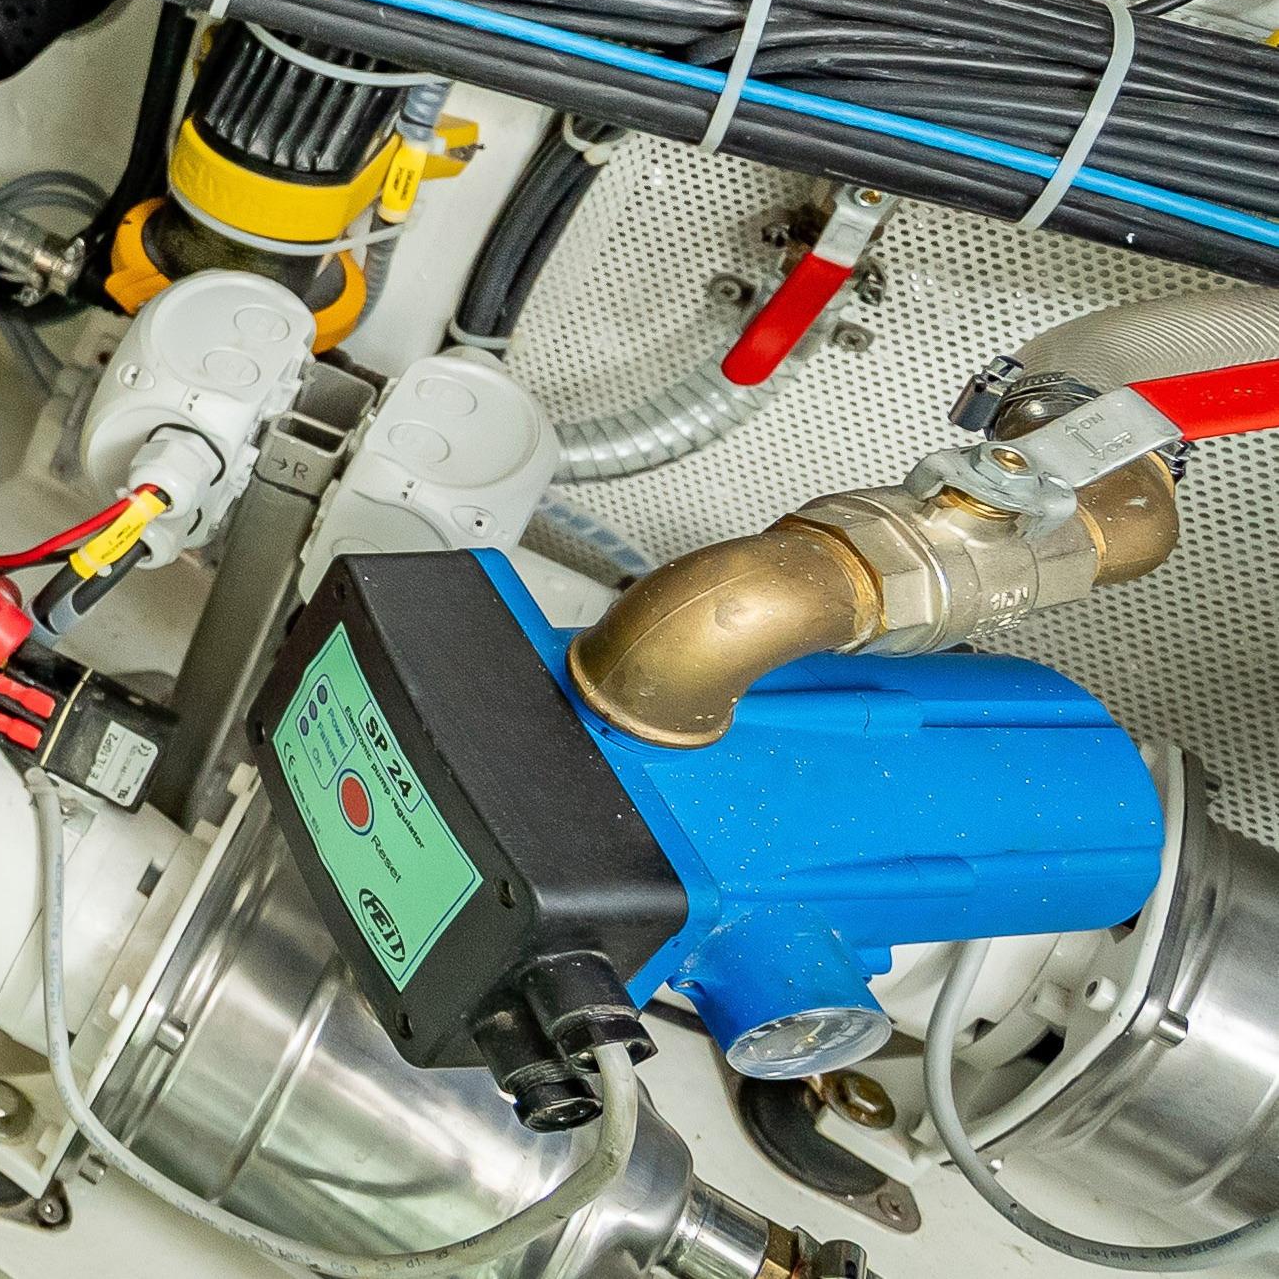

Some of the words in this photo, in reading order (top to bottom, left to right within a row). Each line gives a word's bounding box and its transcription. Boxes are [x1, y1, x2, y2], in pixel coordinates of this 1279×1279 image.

[1078, 413, 1106, 429] ON
[1104, 430, 1133, 453] OFF
[316, 721, 338, 768] Failure
[327, 707, 348, 750] Power
[312, 747, 322, 769] On
[344, 705, 373, 762] Electronic
[370, 763, 391, 795] pump
[391, 797, 426, 849] regulator
[365, 716, 388, 752] SP
[387, 759, 412, 798] 24
[371, 835, 402, 884] Reset
[364, 898, 405, 956] FEIT
[1086, 1246, 1132, 1262] Water
